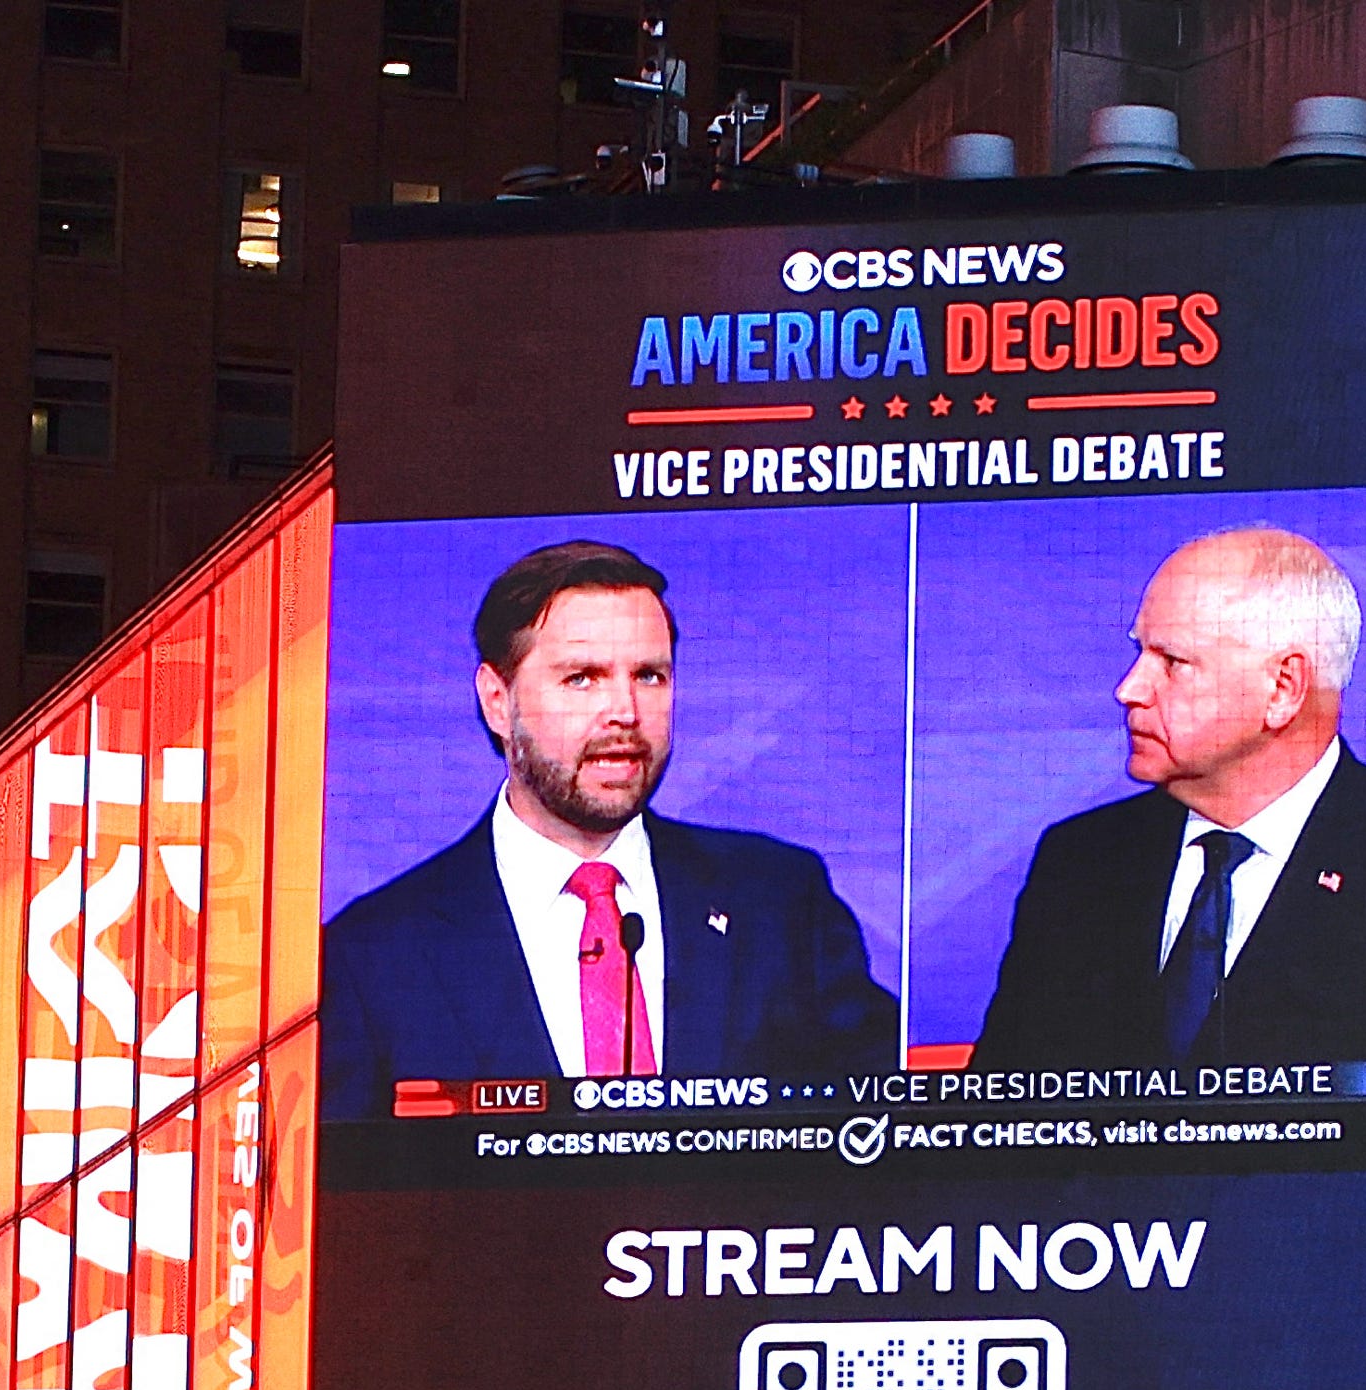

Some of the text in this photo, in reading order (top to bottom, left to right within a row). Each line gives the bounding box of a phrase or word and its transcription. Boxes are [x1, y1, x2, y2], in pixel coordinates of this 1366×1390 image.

[823, 243, 1065, 290] CBS NEWS
[631, 293, 1220, 387] AMERICA DECIDES
[613, 432, 1225, 498] VICE PRESIDENTIAL DEBATE
[480, 1085, 540, 1108] LIVE
[601, 1077, 768, 1109] CBS NEWS
[849, 1065, 1333, 1102] VICE PRESIDENTIAL DEBATE
[477, 1119, 1341, 1157] For CBS NEWS CONFIRMED FACT CHECKS, visit cbsnews.com
[603, 1220, 1207, 1299] STREAM NOW
